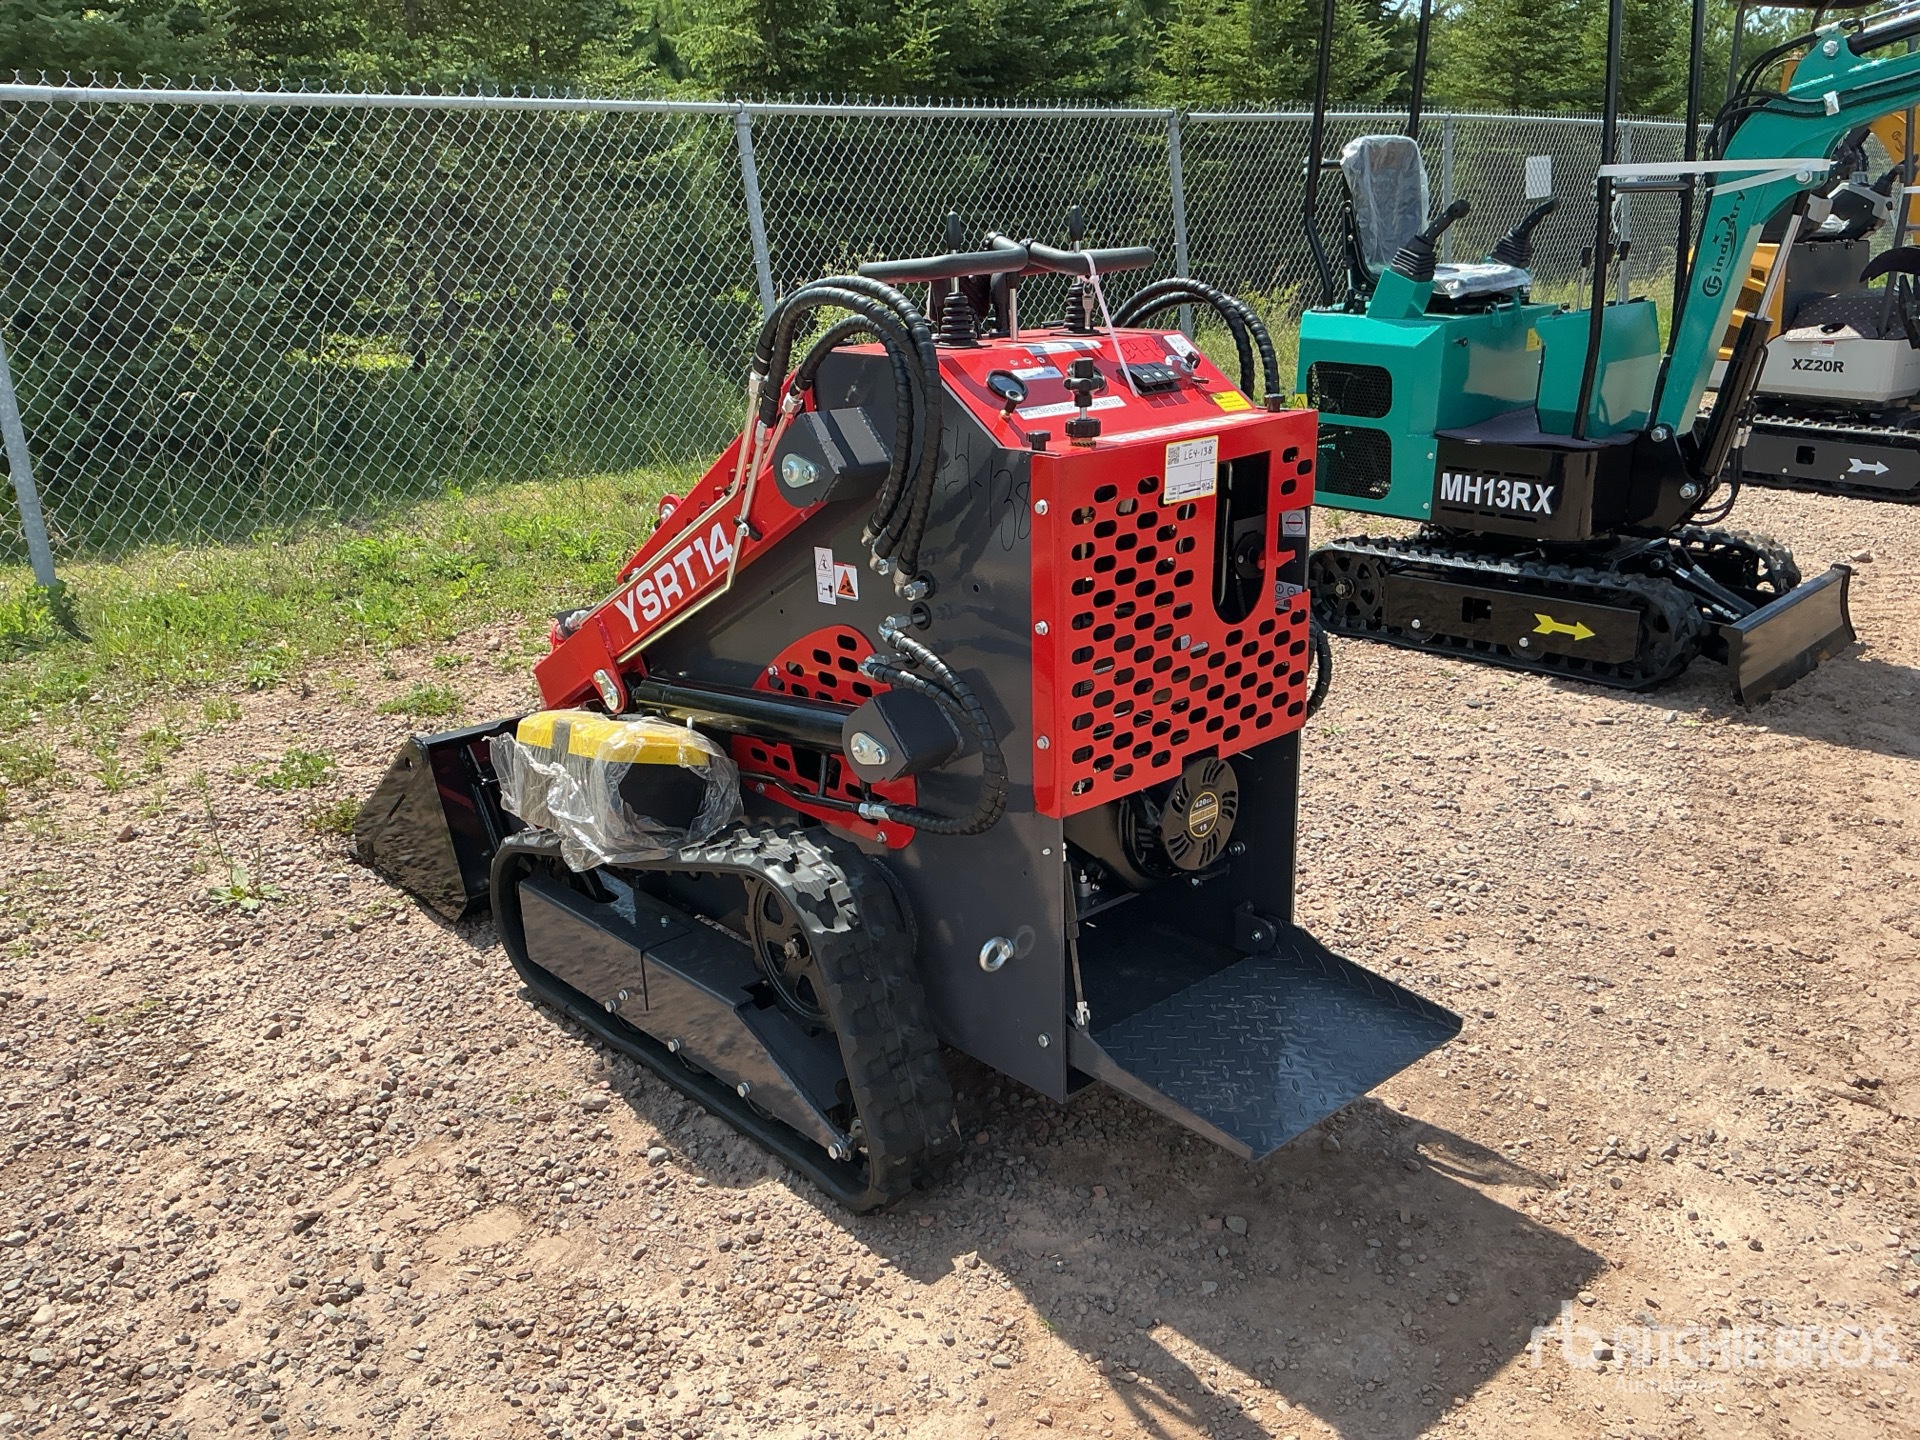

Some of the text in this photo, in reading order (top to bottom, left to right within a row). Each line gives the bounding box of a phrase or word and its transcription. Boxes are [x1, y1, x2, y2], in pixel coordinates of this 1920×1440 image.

[1791, 358, 1845, 373] XZ20R
[1184, 446, 1213, 461] LE4-138
[1439, 472, 1556, 514] MH13RX
[614, 522, 735, 634] YSRT14
